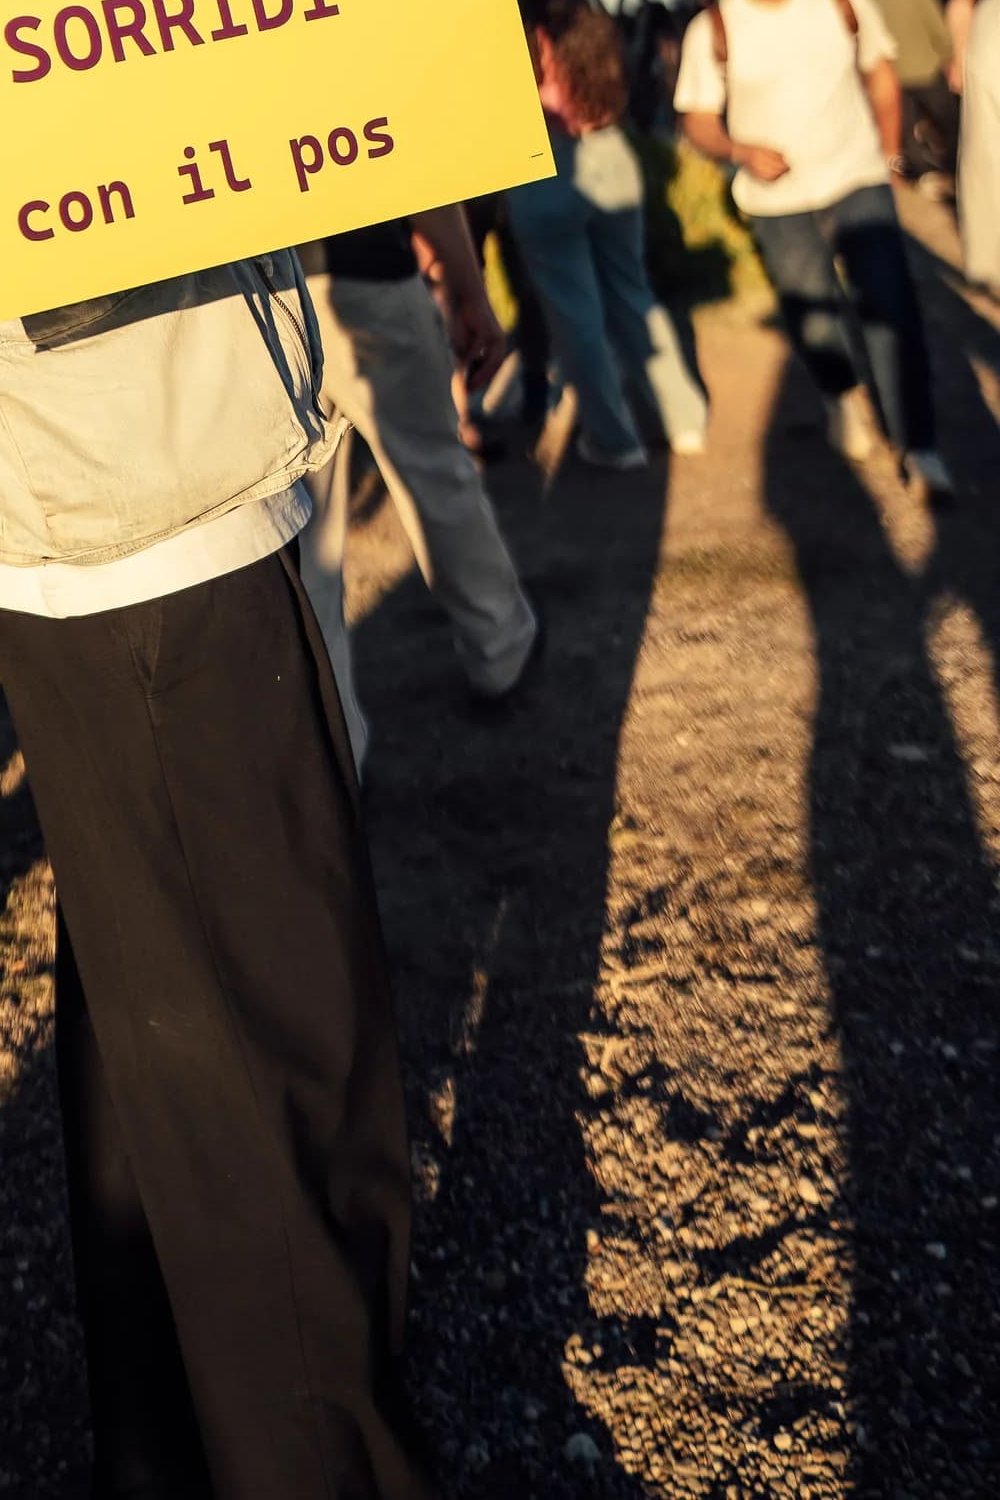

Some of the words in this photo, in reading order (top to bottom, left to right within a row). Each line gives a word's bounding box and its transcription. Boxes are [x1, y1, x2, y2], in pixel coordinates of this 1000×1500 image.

[18, 181, 135, 241] con
[178, 140, 252, 204] il
[289, 117, 394, 192] pos
